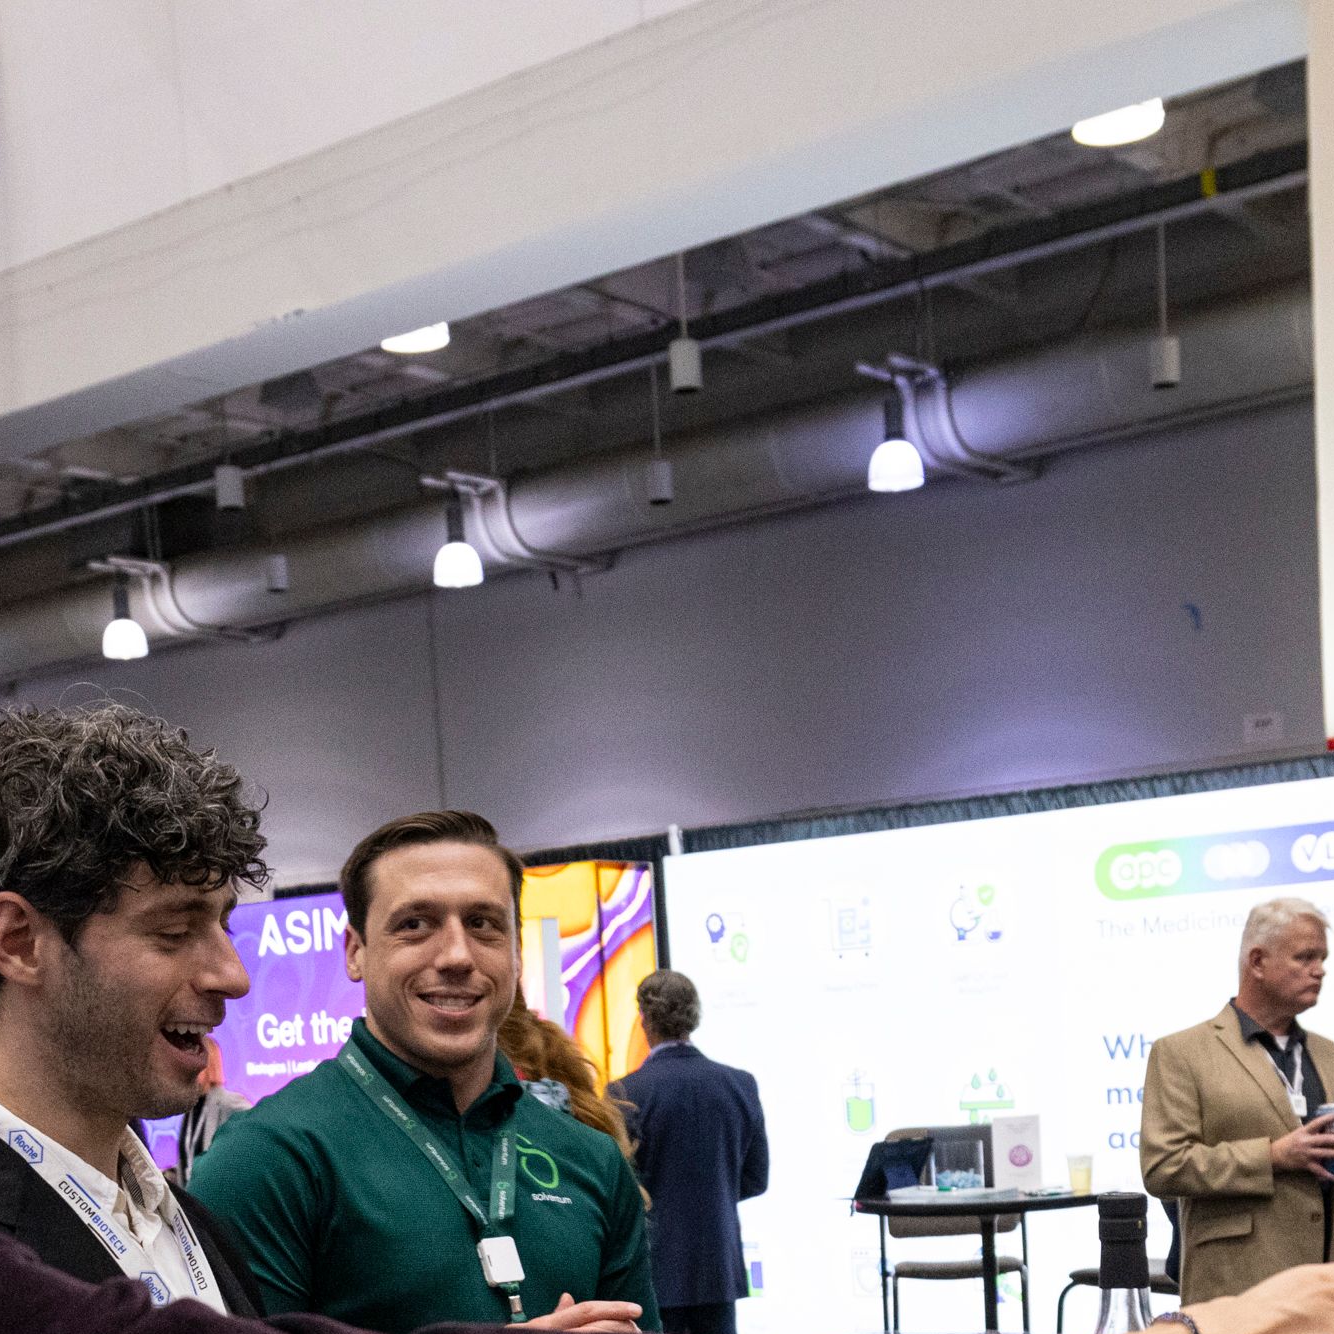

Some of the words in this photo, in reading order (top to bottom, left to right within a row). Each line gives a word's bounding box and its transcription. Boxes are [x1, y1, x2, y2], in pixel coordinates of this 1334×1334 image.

[1096, 918, 1136, 939] The
[1143, 910, 1245, 936] Medicine
[257, 1013, 306, 1048] Get
[310, 1010, 353, 1045] the
[13, 1134, 38, 1160] Roche
[531, 1192, 573, 1205] solventum
[144, 1276, 165, 1302] Roche
